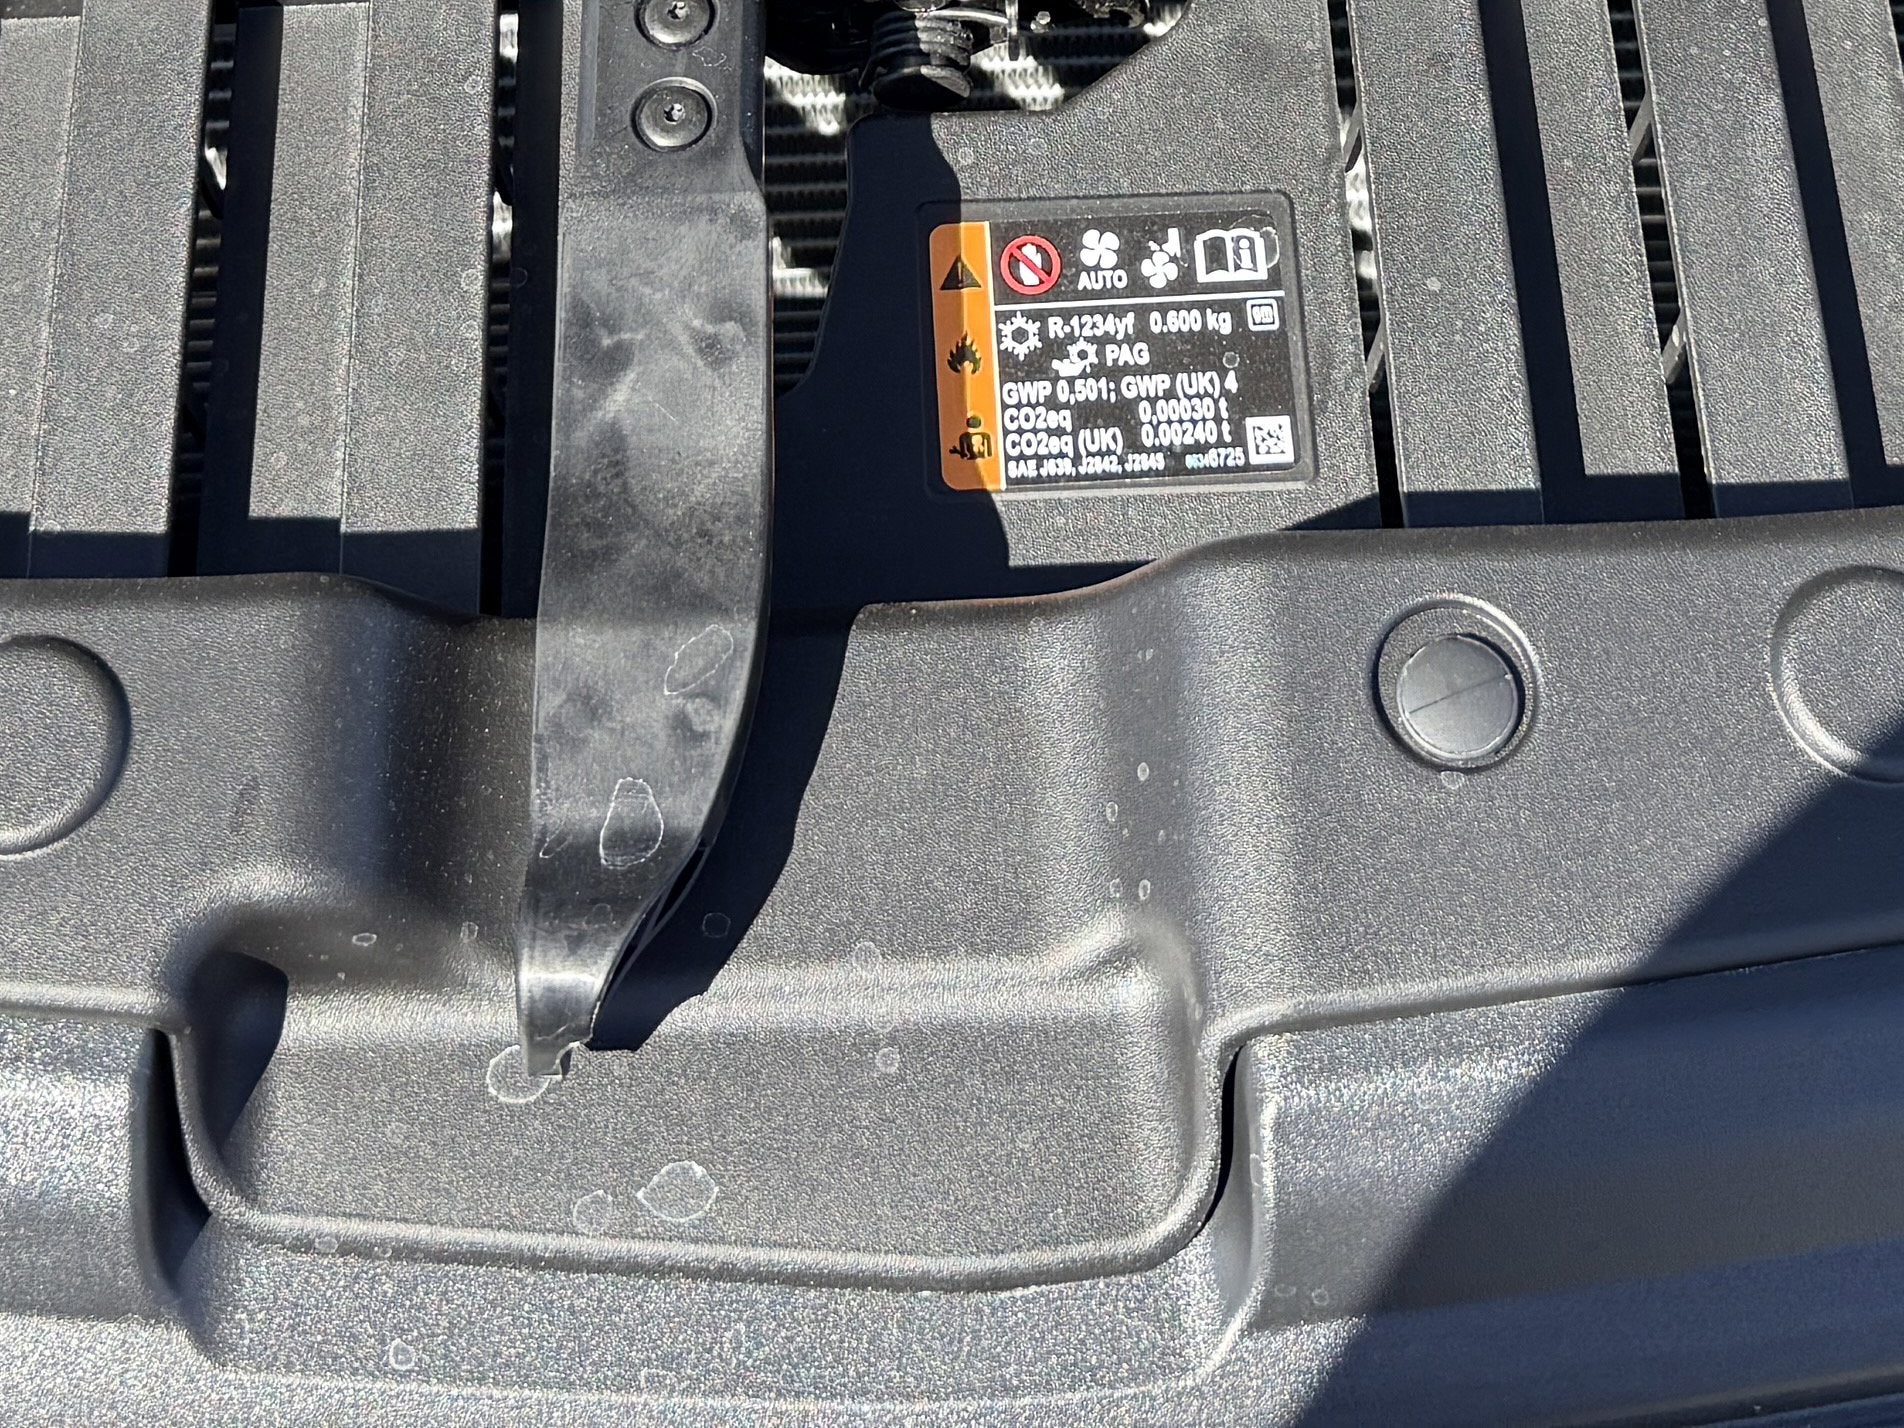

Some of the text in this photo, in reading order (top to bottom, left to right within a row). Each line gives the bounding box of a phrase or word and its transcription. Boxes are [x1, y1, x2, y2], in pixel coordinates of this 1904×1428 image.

[1077, 269, 1128, 291] AUTO
[1048, 308, 1233, 340] R-1234yf 0.600 kg
[1105, 342, 1151, 366] PAG
[1002, 369, 1239, 406] GWP 0,501; GWP (UK) 4
[1003, 405, 1073, 433] CO2eq
[1218, 396, 1229, 420] t
[1005, 431, 1074, 458] CO2eq
[1078, 427, 1124, 456] (UK)
[1221, 419, 1232, 443] t
[1007, 458, 1038, 479] SAE
